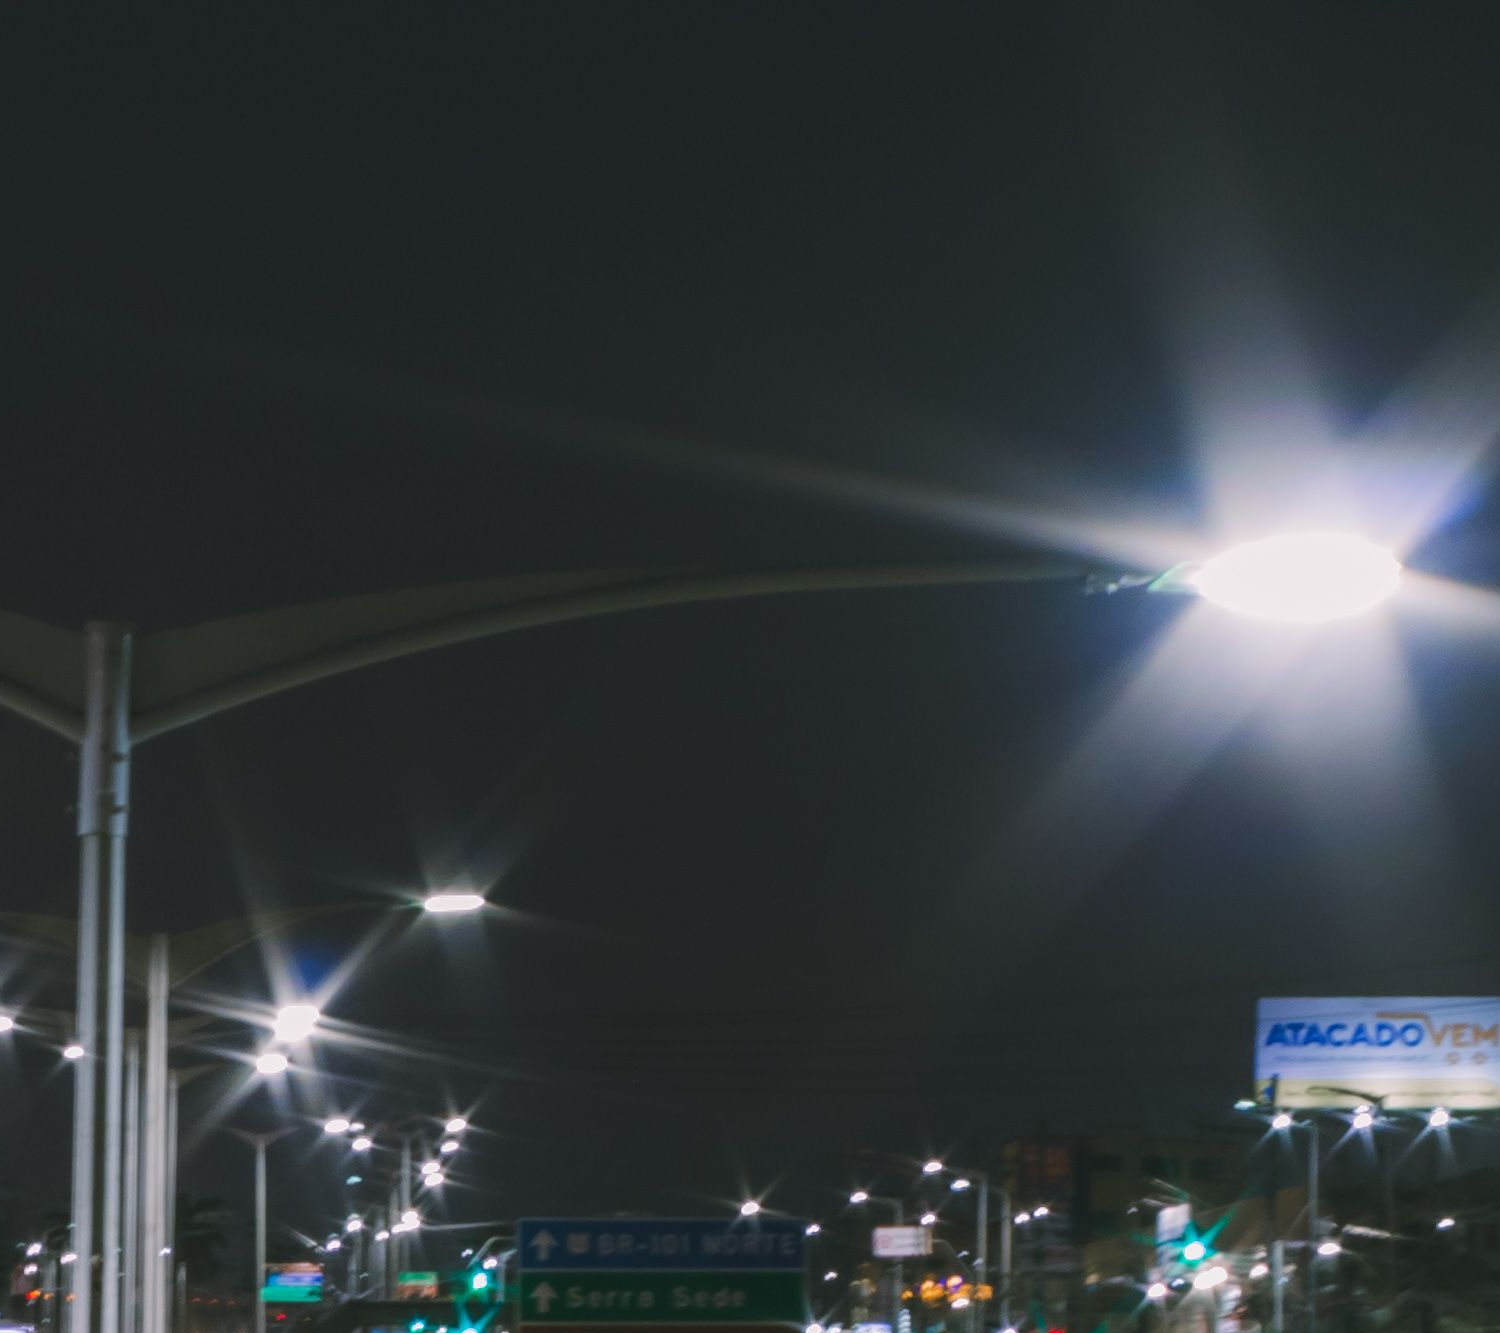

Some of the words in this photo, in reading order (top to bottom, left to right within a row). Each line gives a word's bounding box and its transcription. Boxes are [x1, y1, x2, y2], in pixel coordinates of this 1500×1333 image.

[597, 1232, 690, 1256] BR-101
[700, 1231, 797, 1256] NORTE
[565, 1285, 656, 1309] Serra
[671, 1284, 747, 1309] Sede
